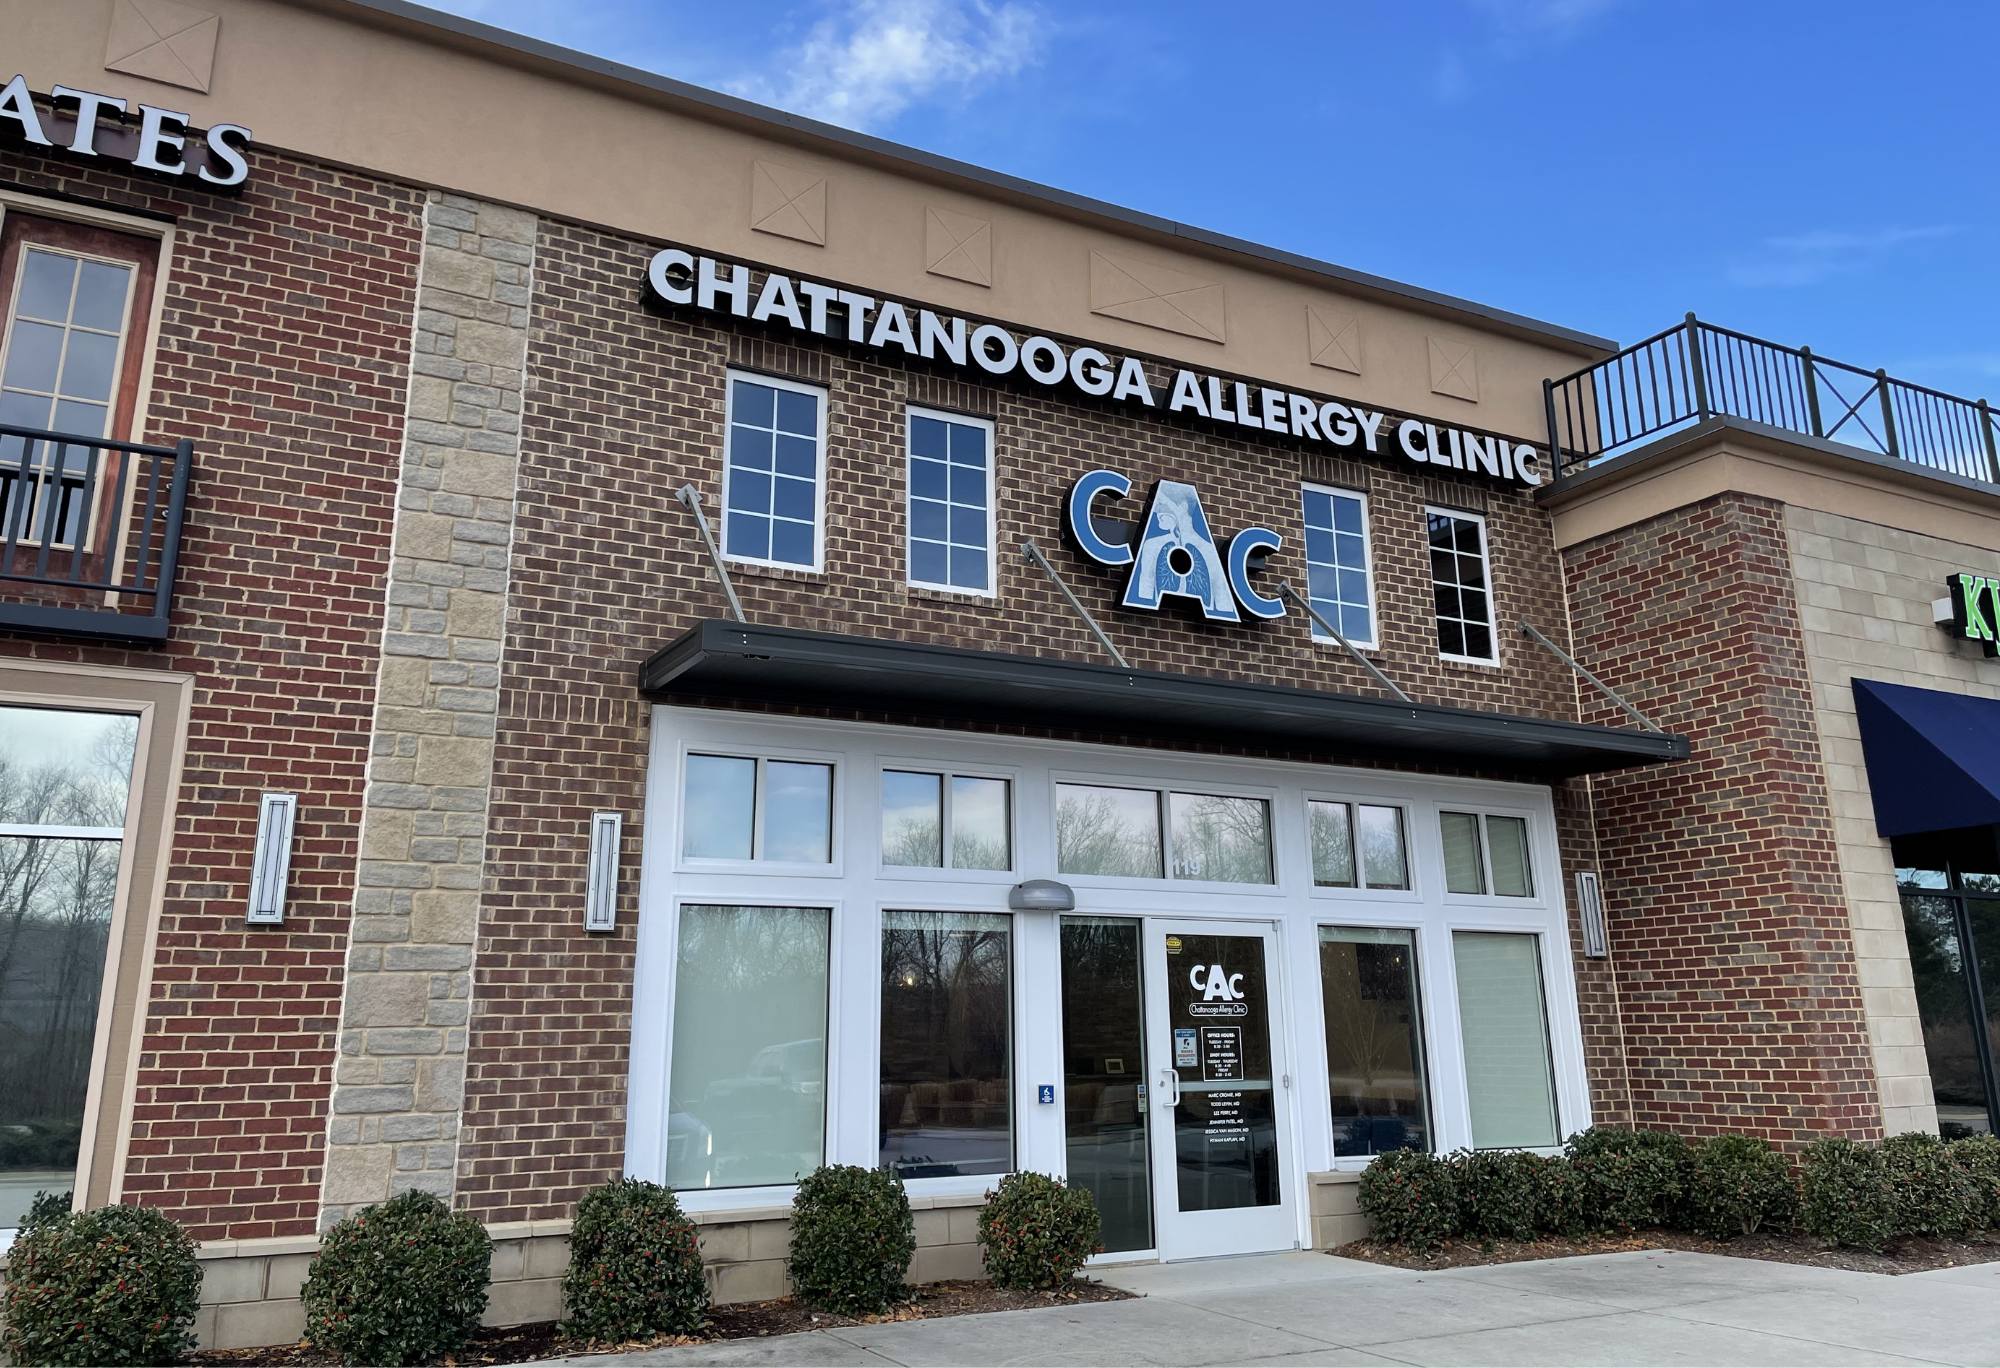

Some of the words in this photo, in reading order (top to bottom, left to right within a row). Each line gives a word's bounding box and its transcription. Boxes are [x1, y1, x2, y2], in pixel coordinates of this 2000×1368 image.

[0, 74, 252, 185] ATES
[649, 249, 1155, 406] CHATTANOOGA
[1169, 369, 1384, 452] ALLERGY
[1399, 419, 1541, 486] CLINIC
[1070, 469, 1287, 623] CAC
[1172, 858, 1200, 875] 119
[1190, 964, 1244, 1000] CAC
[1191, 1004, 1218, 1014] Chattanooga
[1219, 1004, 1232, 1014] Allergy
[1233, 1004, 1245, 1013] Clinic
